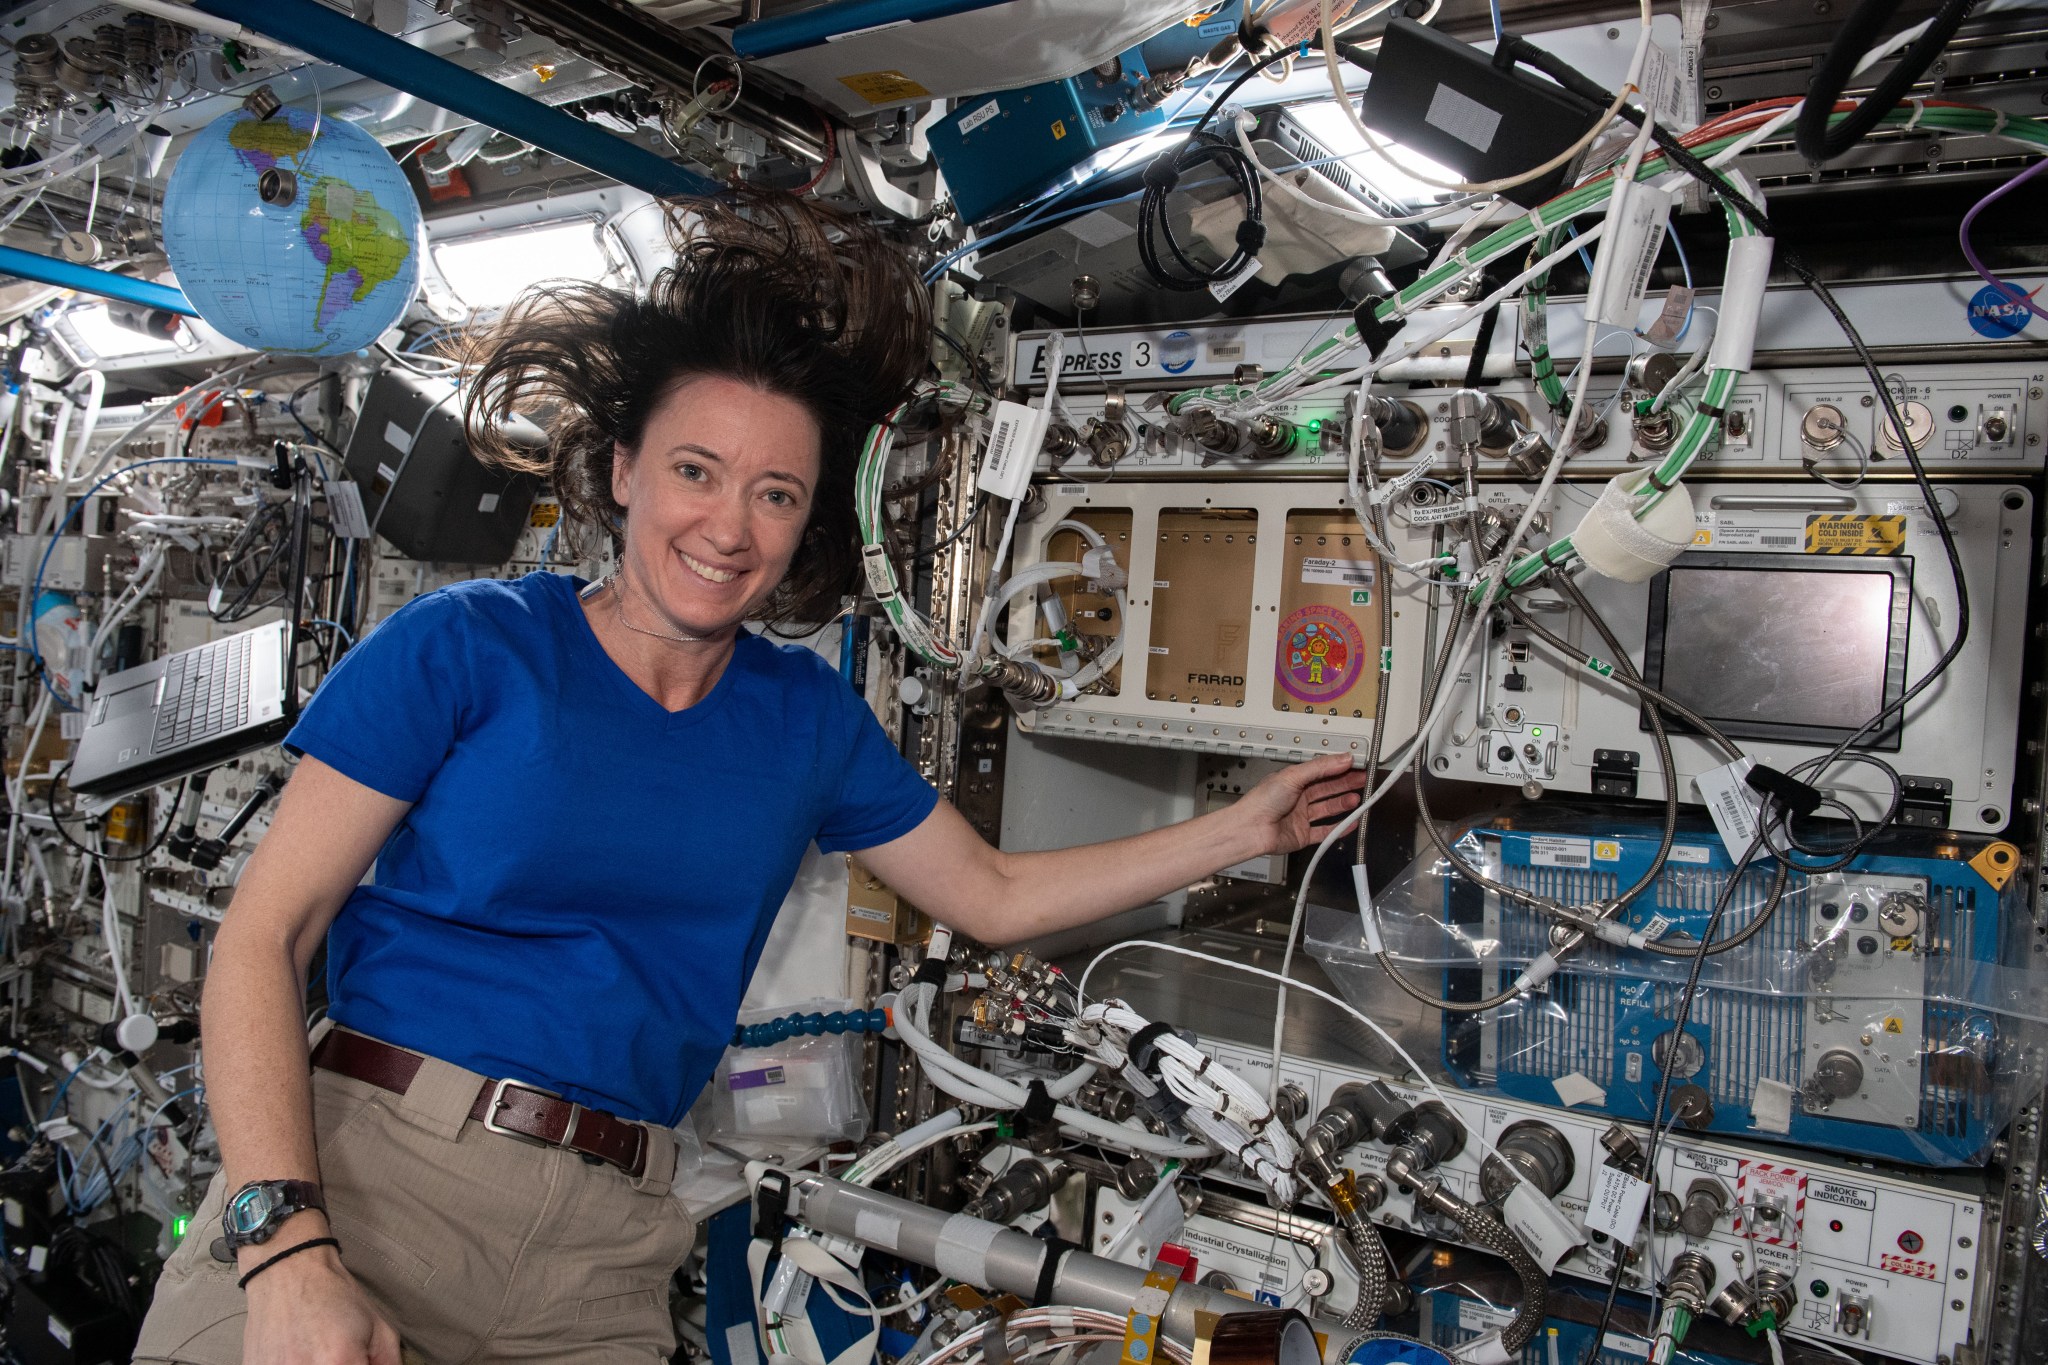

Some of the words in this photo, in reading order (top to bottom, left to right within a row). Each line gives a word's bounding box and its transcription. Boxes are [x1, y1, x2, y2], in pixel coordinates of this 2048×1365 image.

[963, 118, 973, 130] Lab
[973, 111, 986, 124] RSU
[986, 104, 996, 115] PS
[1972, 304, 2029, 317] NASA
[1031, 345, 1122, 374] EPRESS
[1136, 342, 1150, 367] 3
[1952, 450, 1968, 459] D2
[1398, 465, 1421, 483] EXPRESS
[1416, 459, 1434, 477] SUPPLY
[1304, 558, 1336, 567] Faraday-2
[1305, 607, 1332, 616] SPACE
[1188, 673, 1244, 686] FARAD
[1620, 986, 1636, 995] H2O
[1620, 998, 1650, 1008] REFILL
[1247, 1059, 1273, 1070] LAPTOP
[1393, 1092, 1417, 1102] OLANT
[1360, 1152, 1388, 1164] LAPTOP
[1710, 1158, 1728, 1166] 1553
[1695, 1161, 1718, 1171] PORT
[1605, 1172, 1615, 1189] Supply
[1630, 1178, 1637, 1186] P2
[1750, 1169, 1768, 1177] RACK
[1770, 1173, 1796, 1183] POWER
[1824, 1184, 1858, 1198] SMOKE
[1600, 1188, 1610, 1210] OUTPUT
[1814, 1190, 1867, 1207] INDICATION
[1561, 1201, 1588, 1213] LOCKE
[1613, 1203, 1621, 1218] Cable
[1964, 1206, 1974, 1215] F2
[1185, 1230, 1224, 1248] Industrial
[1226, 1242, 1286, 1267] Crystallization
[1756, 1247, 1789, 1260] OCKER
[1587, 1264, 1603, 1274] G2
[1759, 1258, 1781, 1268] POWER
[1845, 1279, 1867, 1288] POWER
[1808, 1320, 1821, 1331] J2
[1340, 1337, 1362, 1364] AGENZIA
